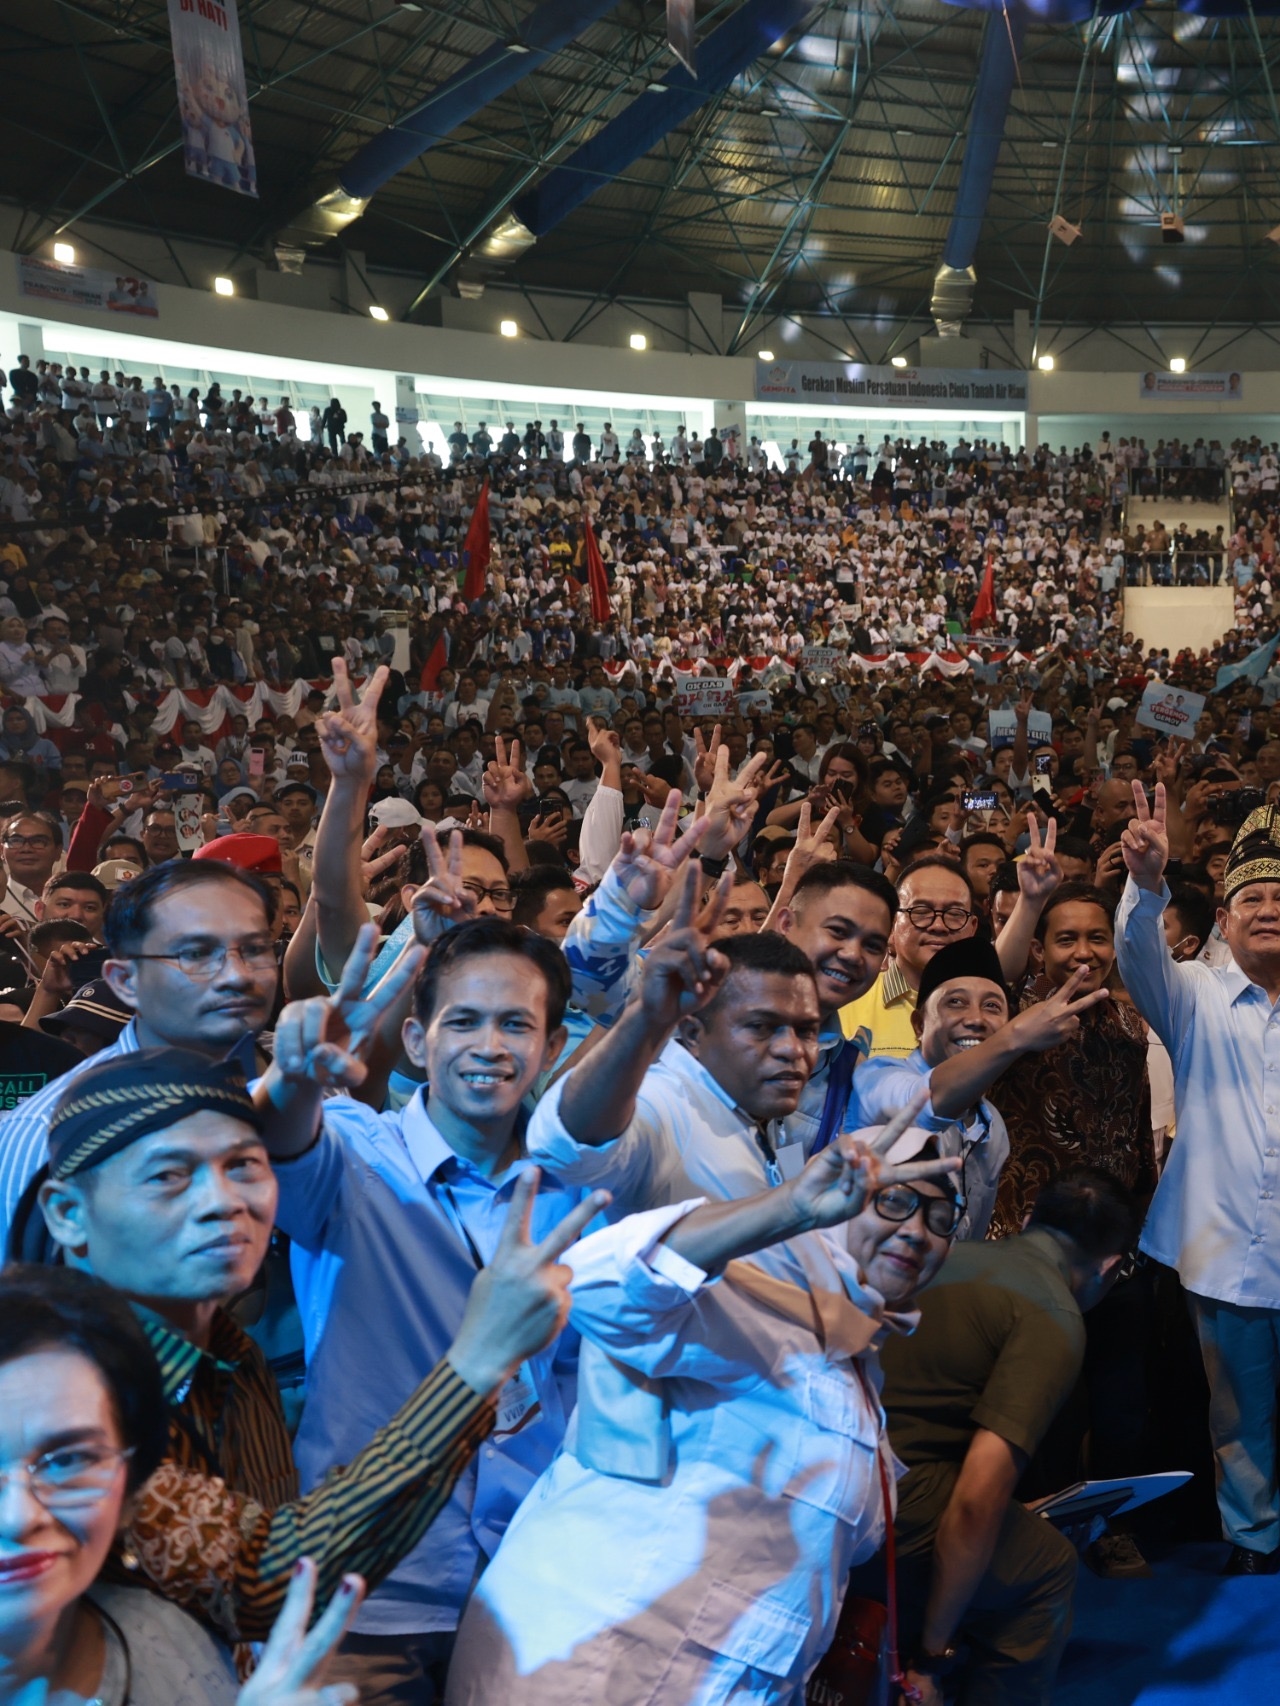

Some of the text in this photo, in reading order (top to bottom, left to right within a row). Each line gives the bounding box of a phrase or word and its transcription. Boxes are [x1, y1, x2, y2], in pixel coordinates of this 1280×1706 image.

[761, 385, 796, 394] GEMPITA
[802, 375, 1025, 399] Gerakan Muslim Persatuan Indonesia Cinta Tanah Air Riau
[687, 681, 724, 691] OK GAS
[1151, 705, 1188, 721] TERGEMOY
[1156, 713, 1180, 726] GEMOY
[504, 1404, 525, 1422] VVIP
